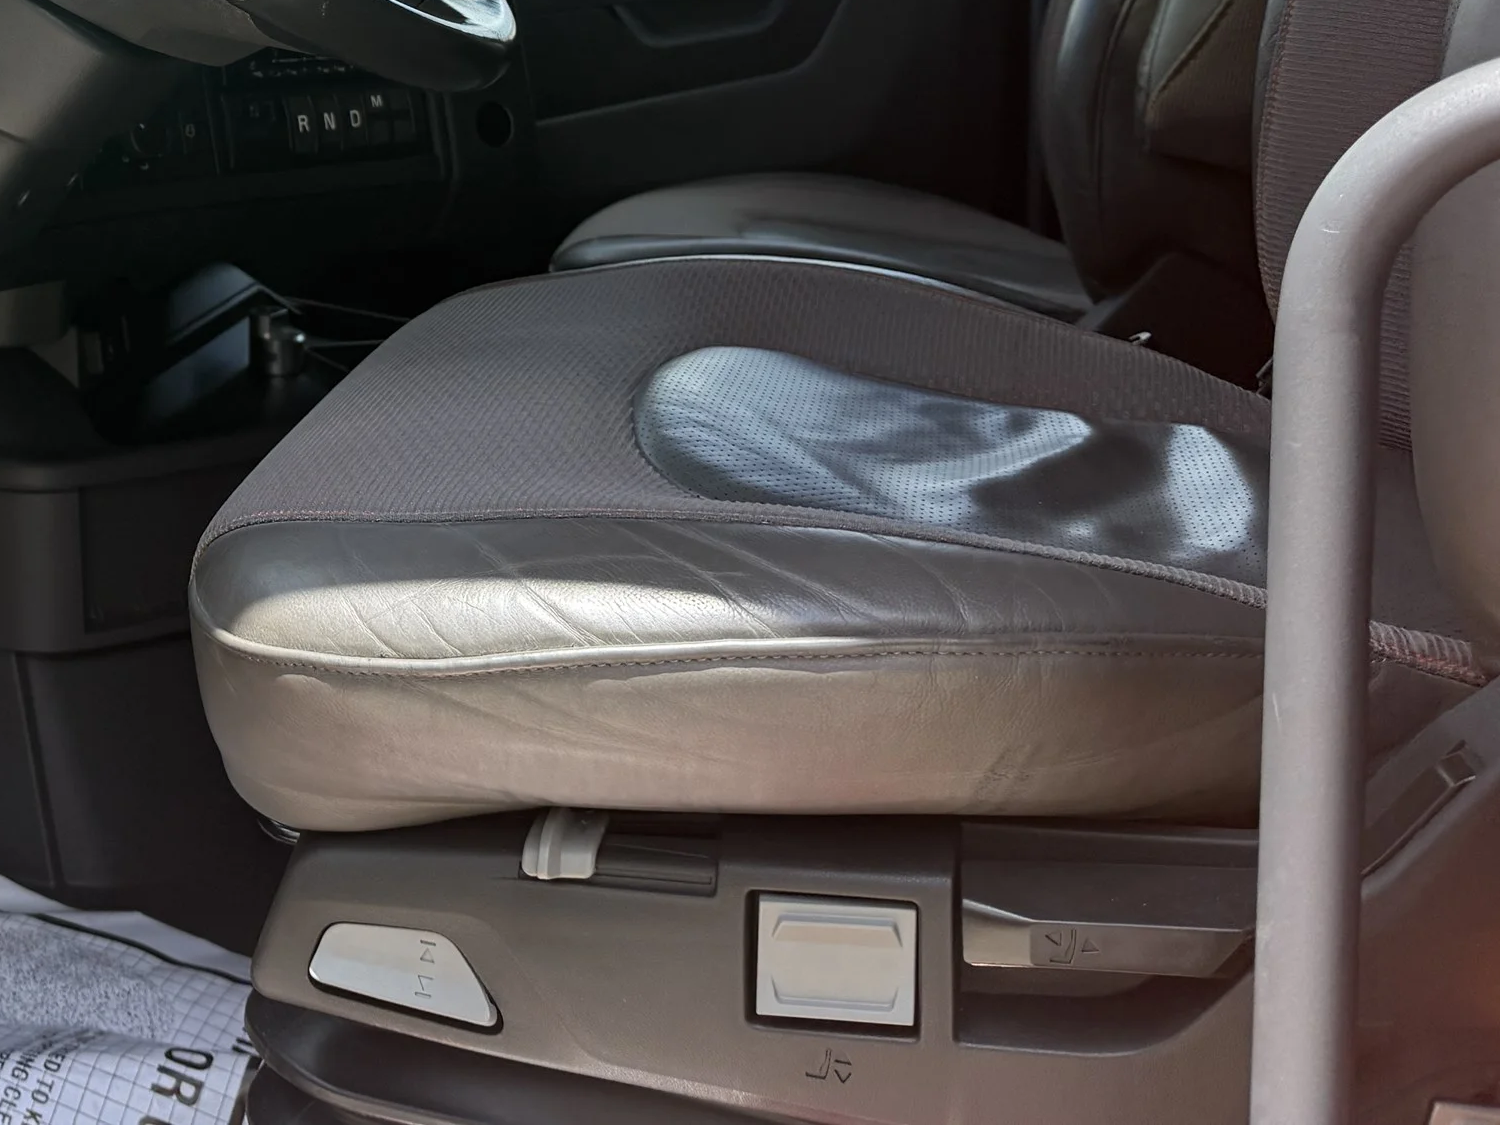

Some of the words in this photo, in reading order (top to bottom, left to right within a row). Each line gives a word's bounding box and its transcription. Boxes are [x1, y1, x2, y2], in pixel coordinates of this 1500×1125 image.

[371, 94, 384, 108] M
[298, 115, 310, 133] R
[324, 112, 337, 130] N
[350, 109, 362, 127] D
[30, 1078, 55, 1105] TO
